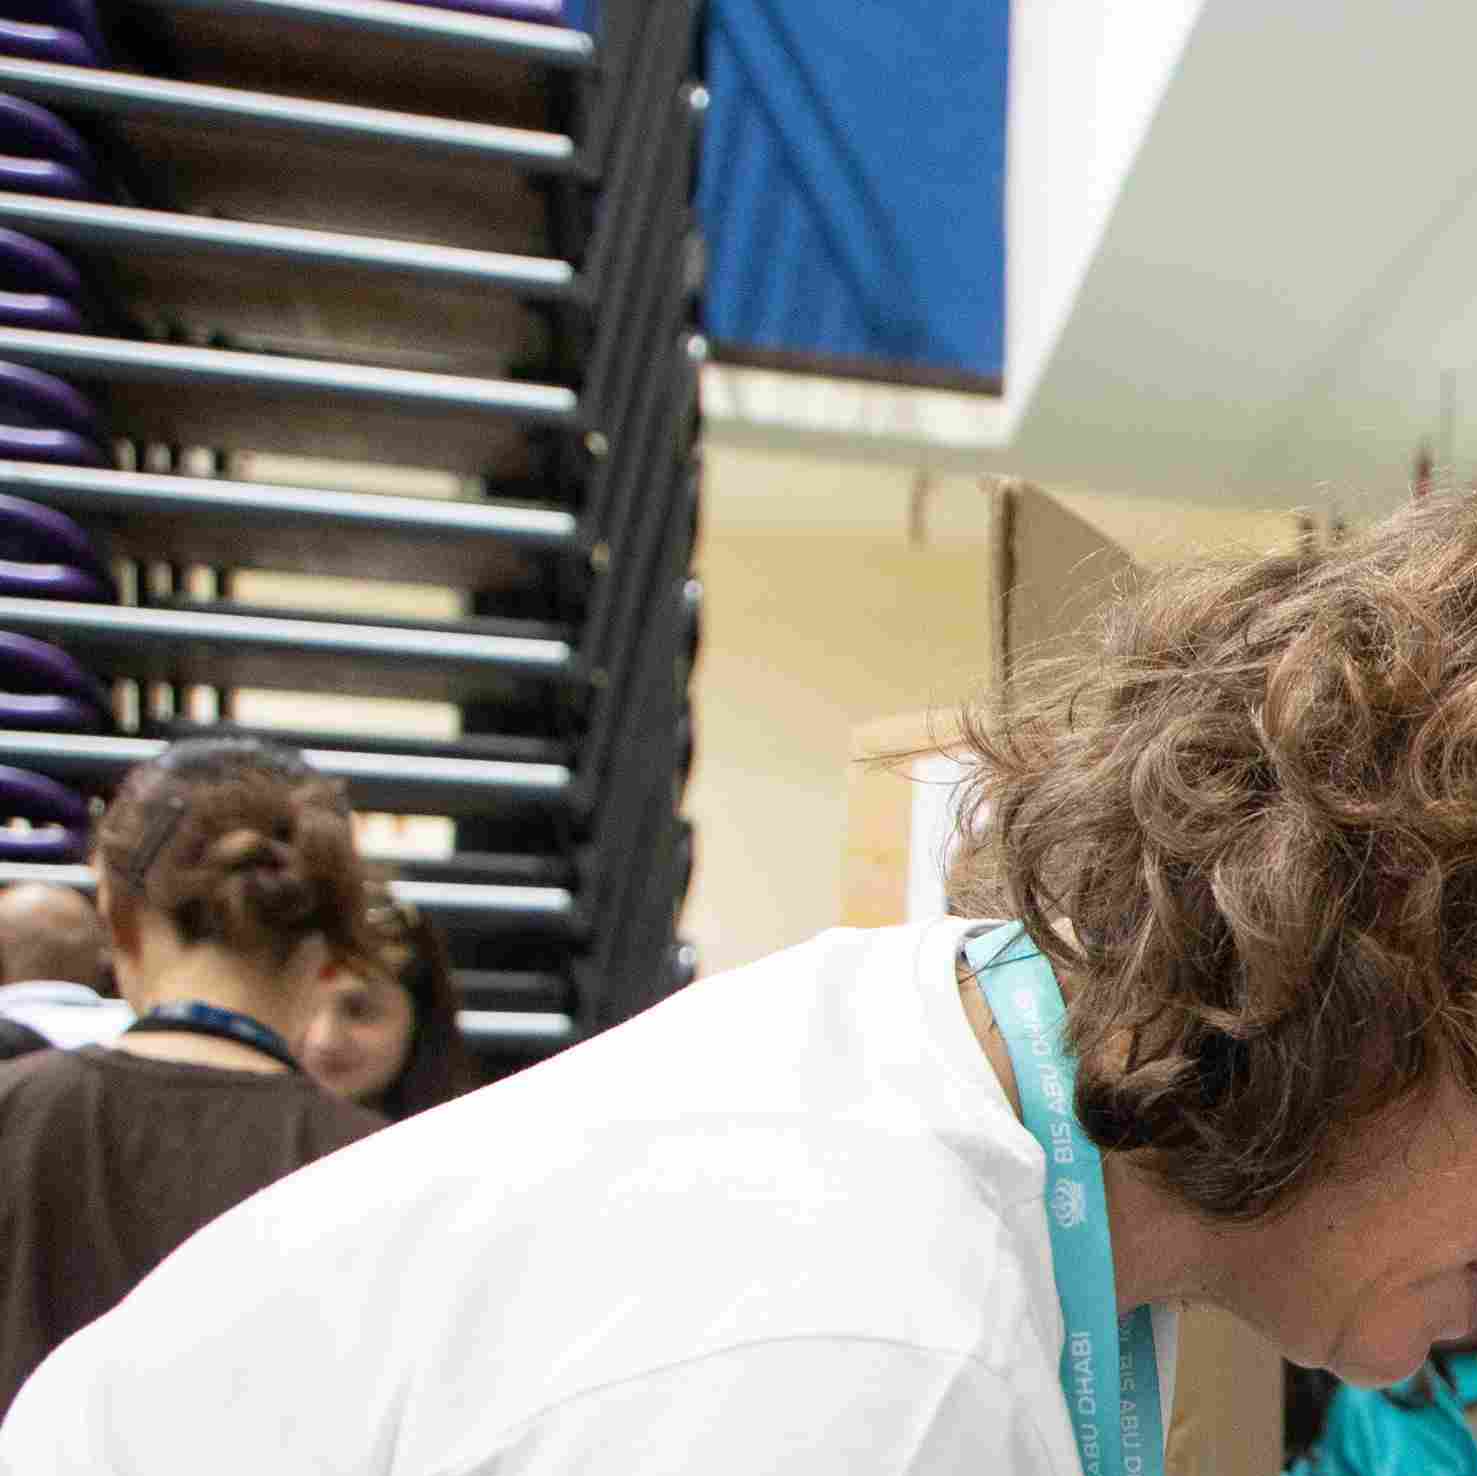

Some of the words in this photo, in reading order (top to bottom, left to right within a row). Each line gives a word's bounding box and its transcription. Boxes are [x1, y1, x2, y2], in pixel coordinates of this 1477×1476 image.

[1049, 1121, 1075, 1165] BIS
[1070, 1330, 1097, 1417] DHABI
[1119, 1398, 1142, 1450] ABU
